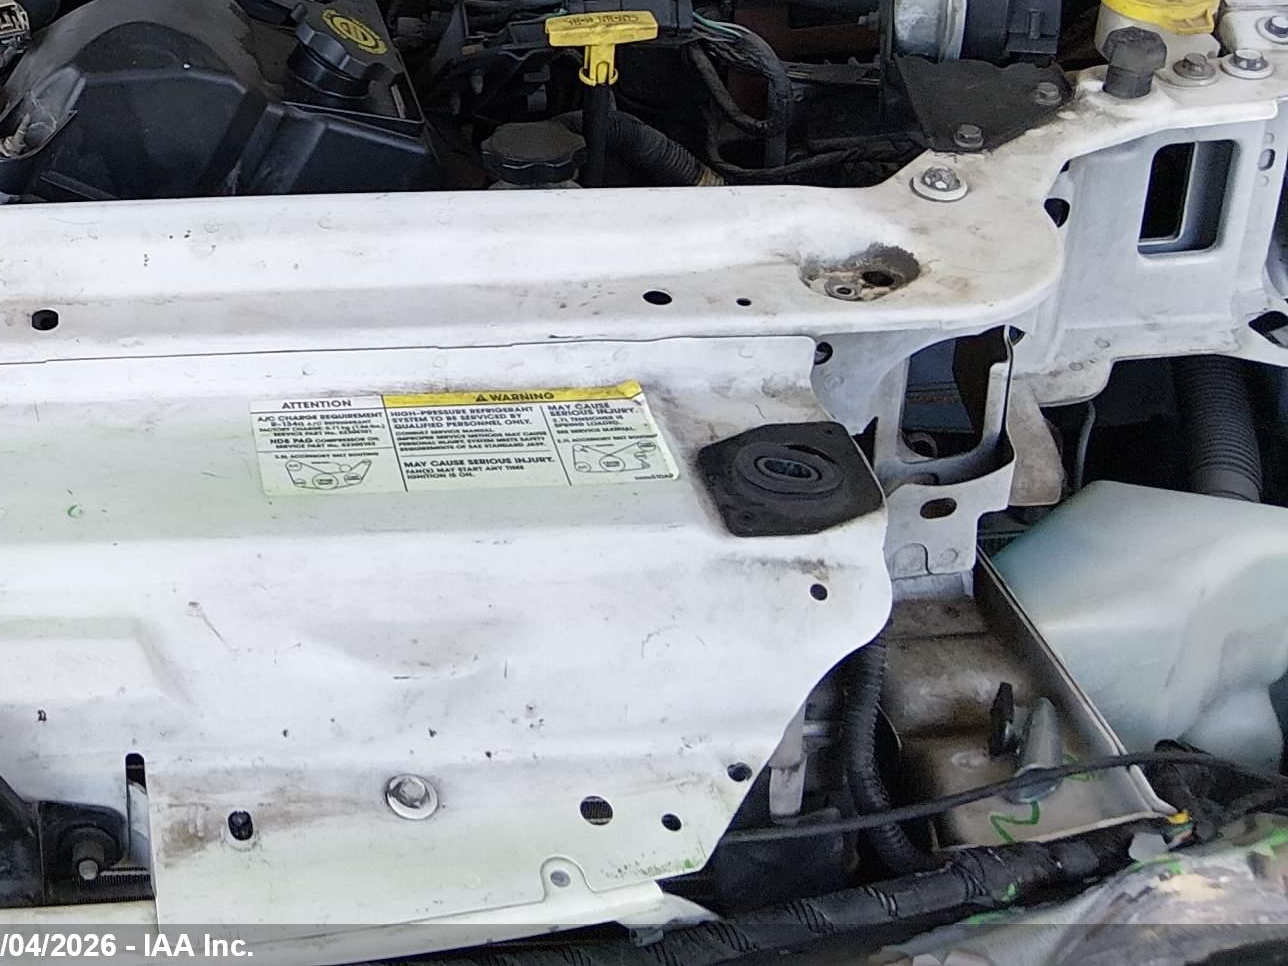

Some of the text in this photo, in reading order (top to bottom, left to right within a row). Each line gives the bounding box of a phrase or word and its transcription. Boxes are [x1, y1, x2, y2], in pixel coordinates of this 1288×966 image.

[490, 393, 554, 401] WARNING
[282, 400, 351, 409] ATTENTION
[391, 408, 467, 417] HIGH-PRESSURE
